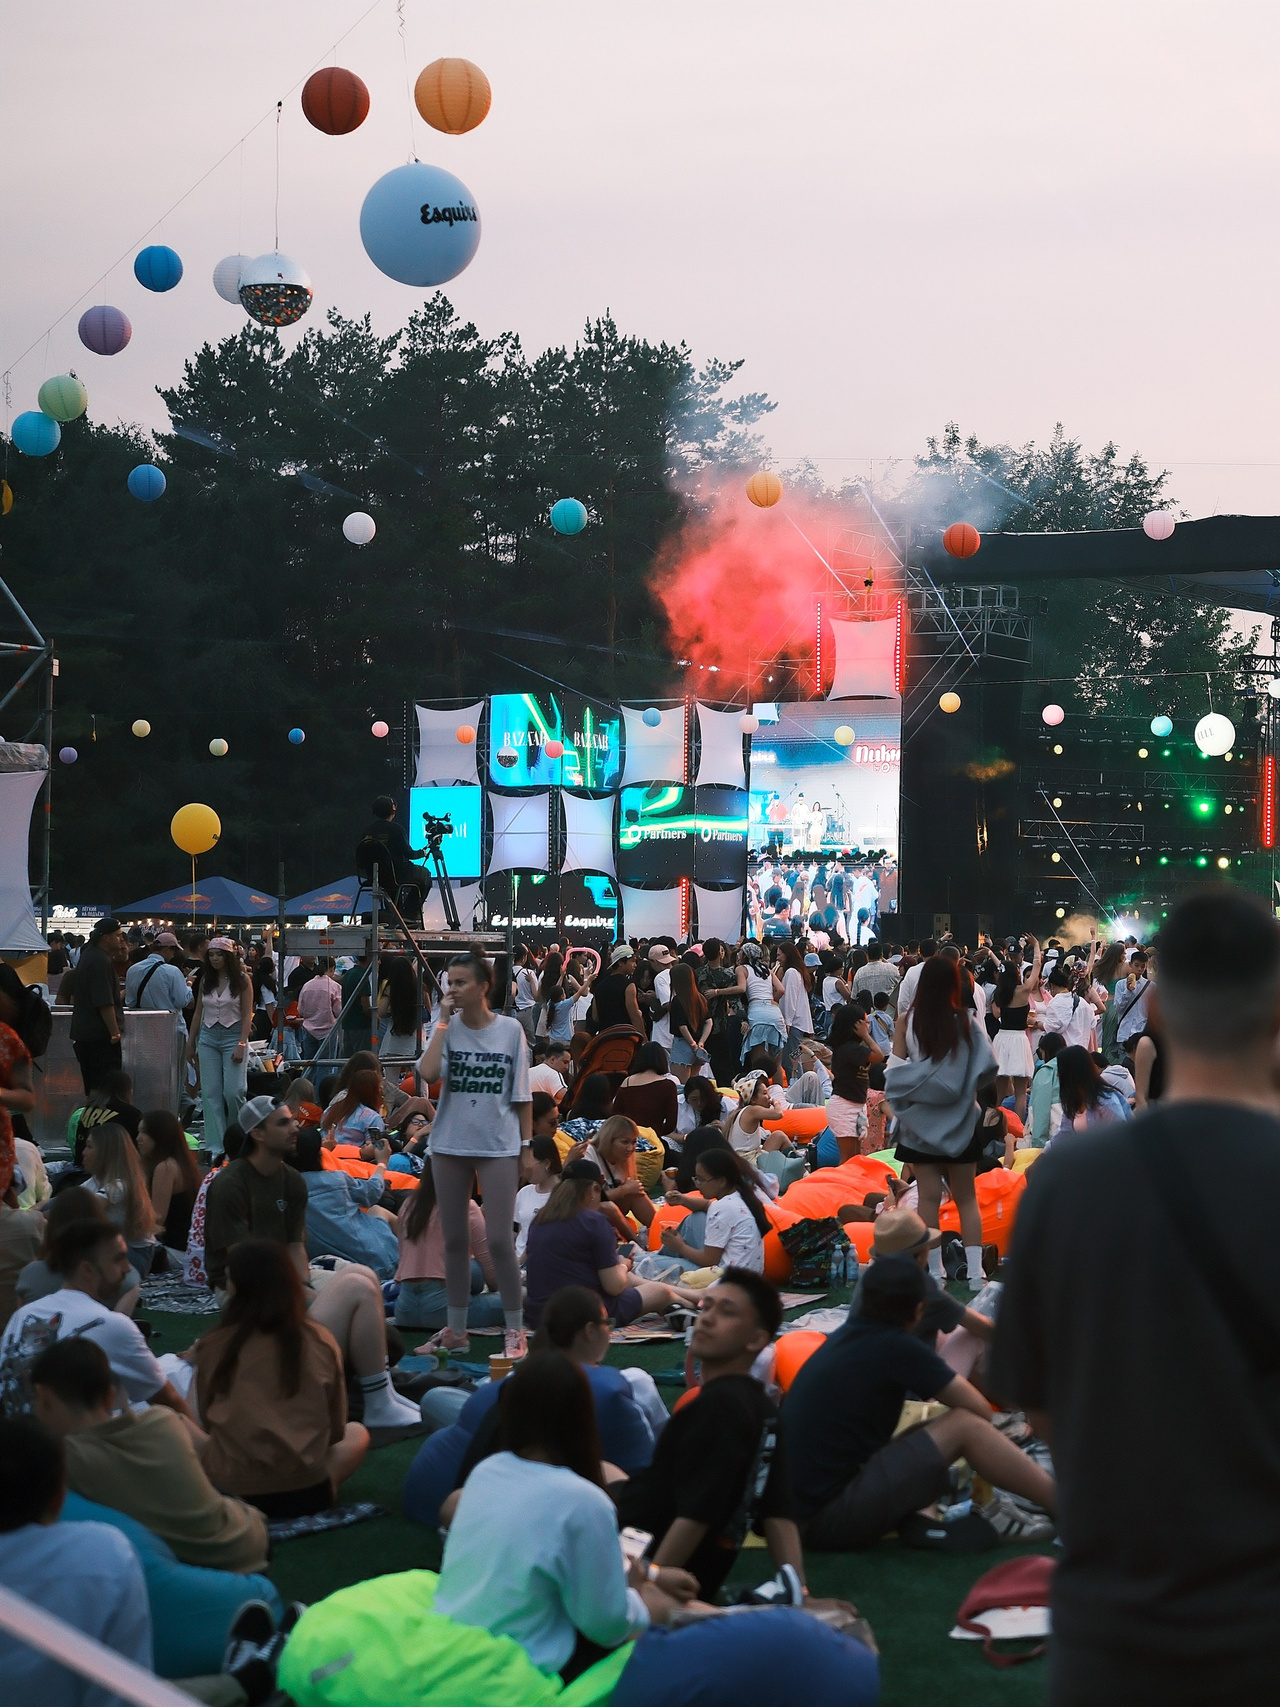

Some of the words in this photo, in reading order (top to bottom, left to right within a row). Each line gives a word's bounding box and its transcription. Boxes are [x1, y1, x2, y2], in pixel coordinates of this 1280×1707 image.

[643, 829, 687, 840] Partners
[712, 829, 743, 842] Partners
[491, 914, 557, 929] Esquire
[564, 914, 615, 929] Esquire
[475, 1052, 504, 1062] TIME
[450, 1062, 506, 1078] Rhode
[450, 1077, 503, 1094] sland
